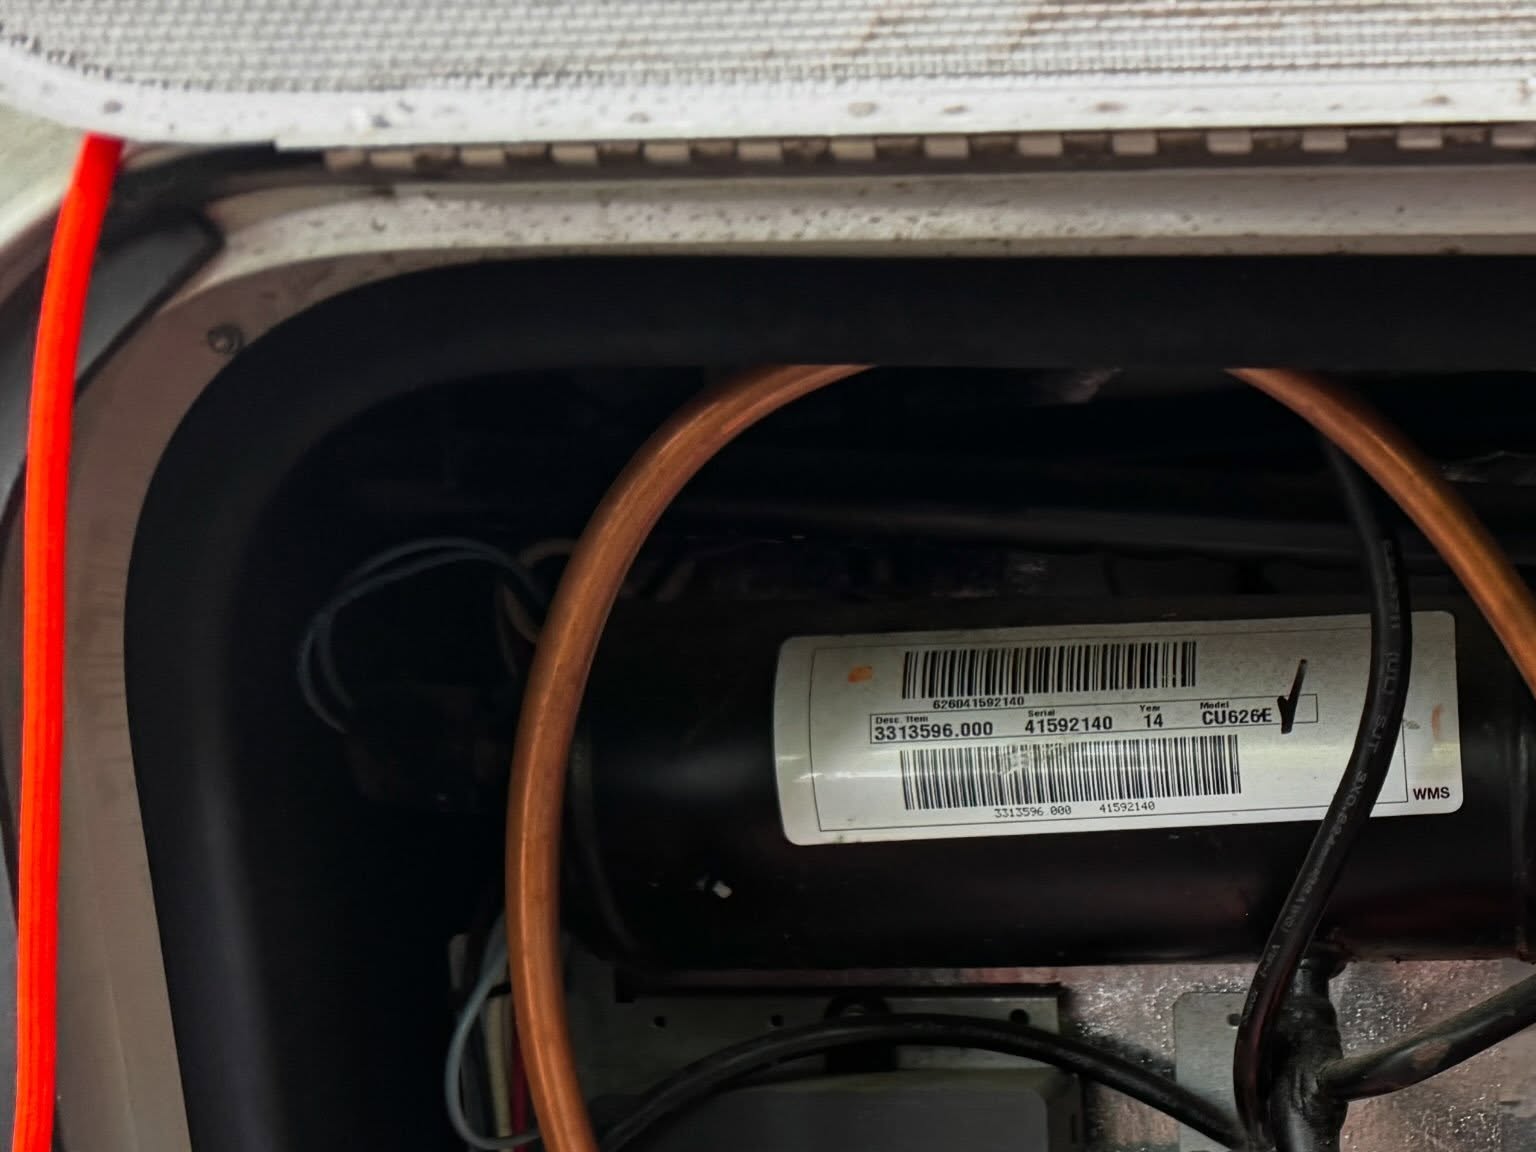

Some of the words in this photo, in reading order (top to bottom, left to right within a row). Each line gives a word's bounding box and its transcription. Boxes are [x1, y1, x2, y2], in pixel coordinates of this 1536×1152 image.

[1200, 701, 1229, 709] Model
[874, 721, 993, 741] 3313596.000
[1025, 716, 1113, 734] 41592140
[1145, 714, 1164, 728] 14
[1202, 708, 1273, 725] CU626E
[1413, 786, 1450, 800] WMS
[1099, 801, 1156, 813] 41592140
